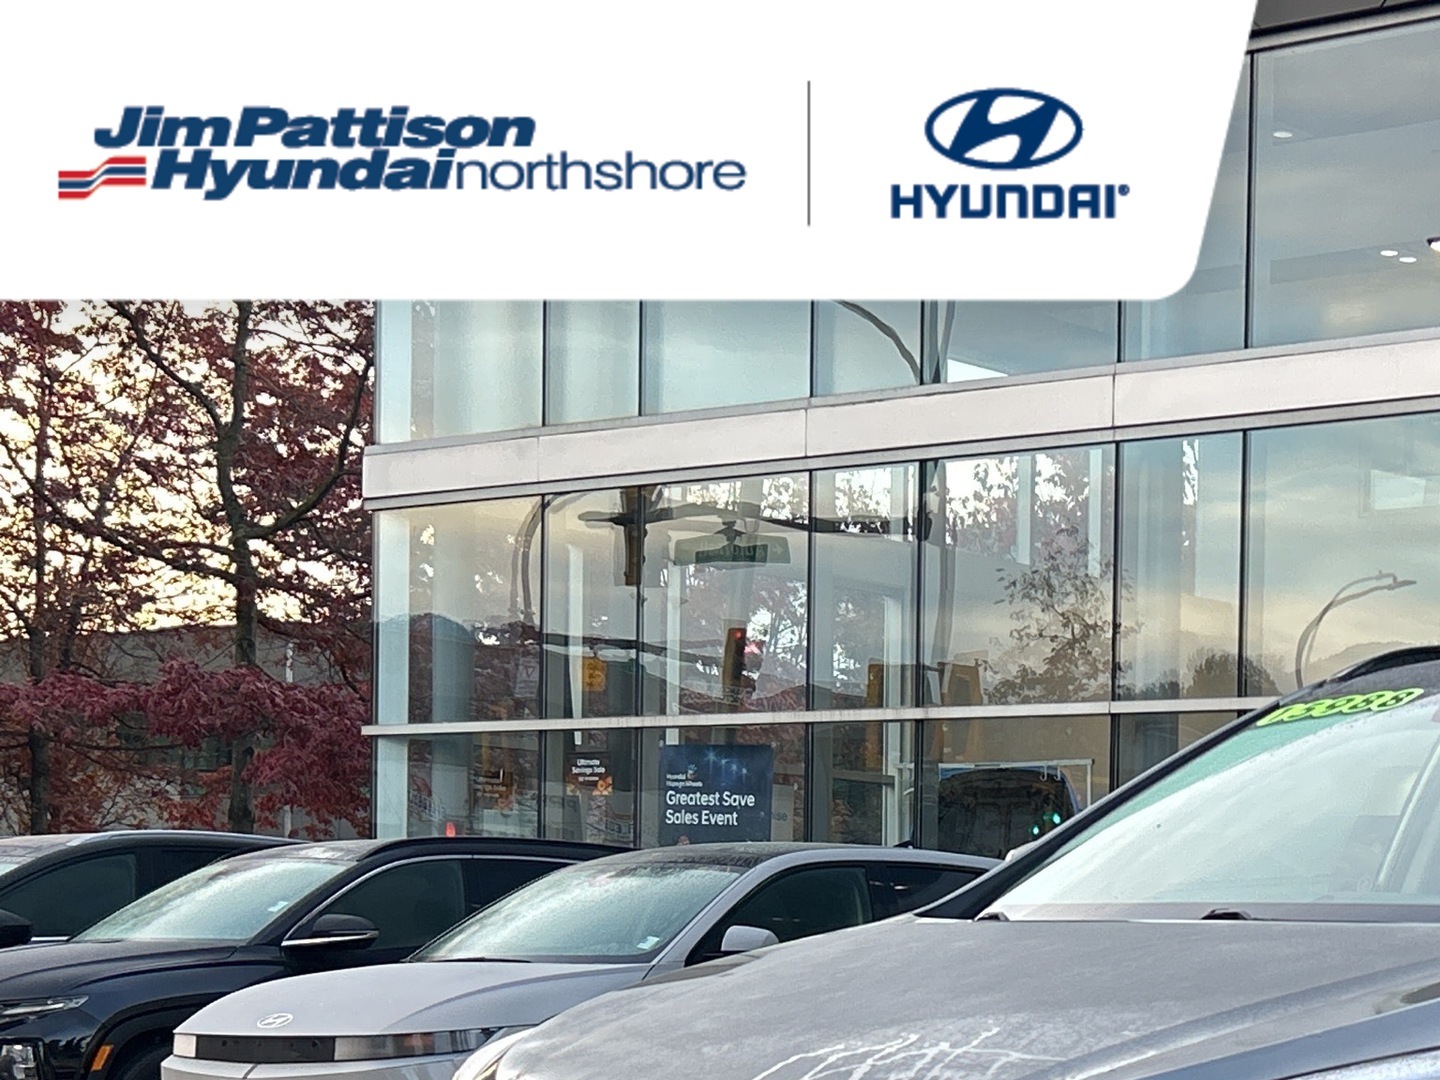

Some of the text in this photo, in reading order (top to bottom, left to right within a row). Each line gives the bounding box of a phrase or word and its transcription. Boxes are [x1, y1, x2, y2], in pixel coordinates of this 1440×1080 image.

[666, 790, 755, 807] Greatest Save
[665, 809, 738, 826] Sales Event
